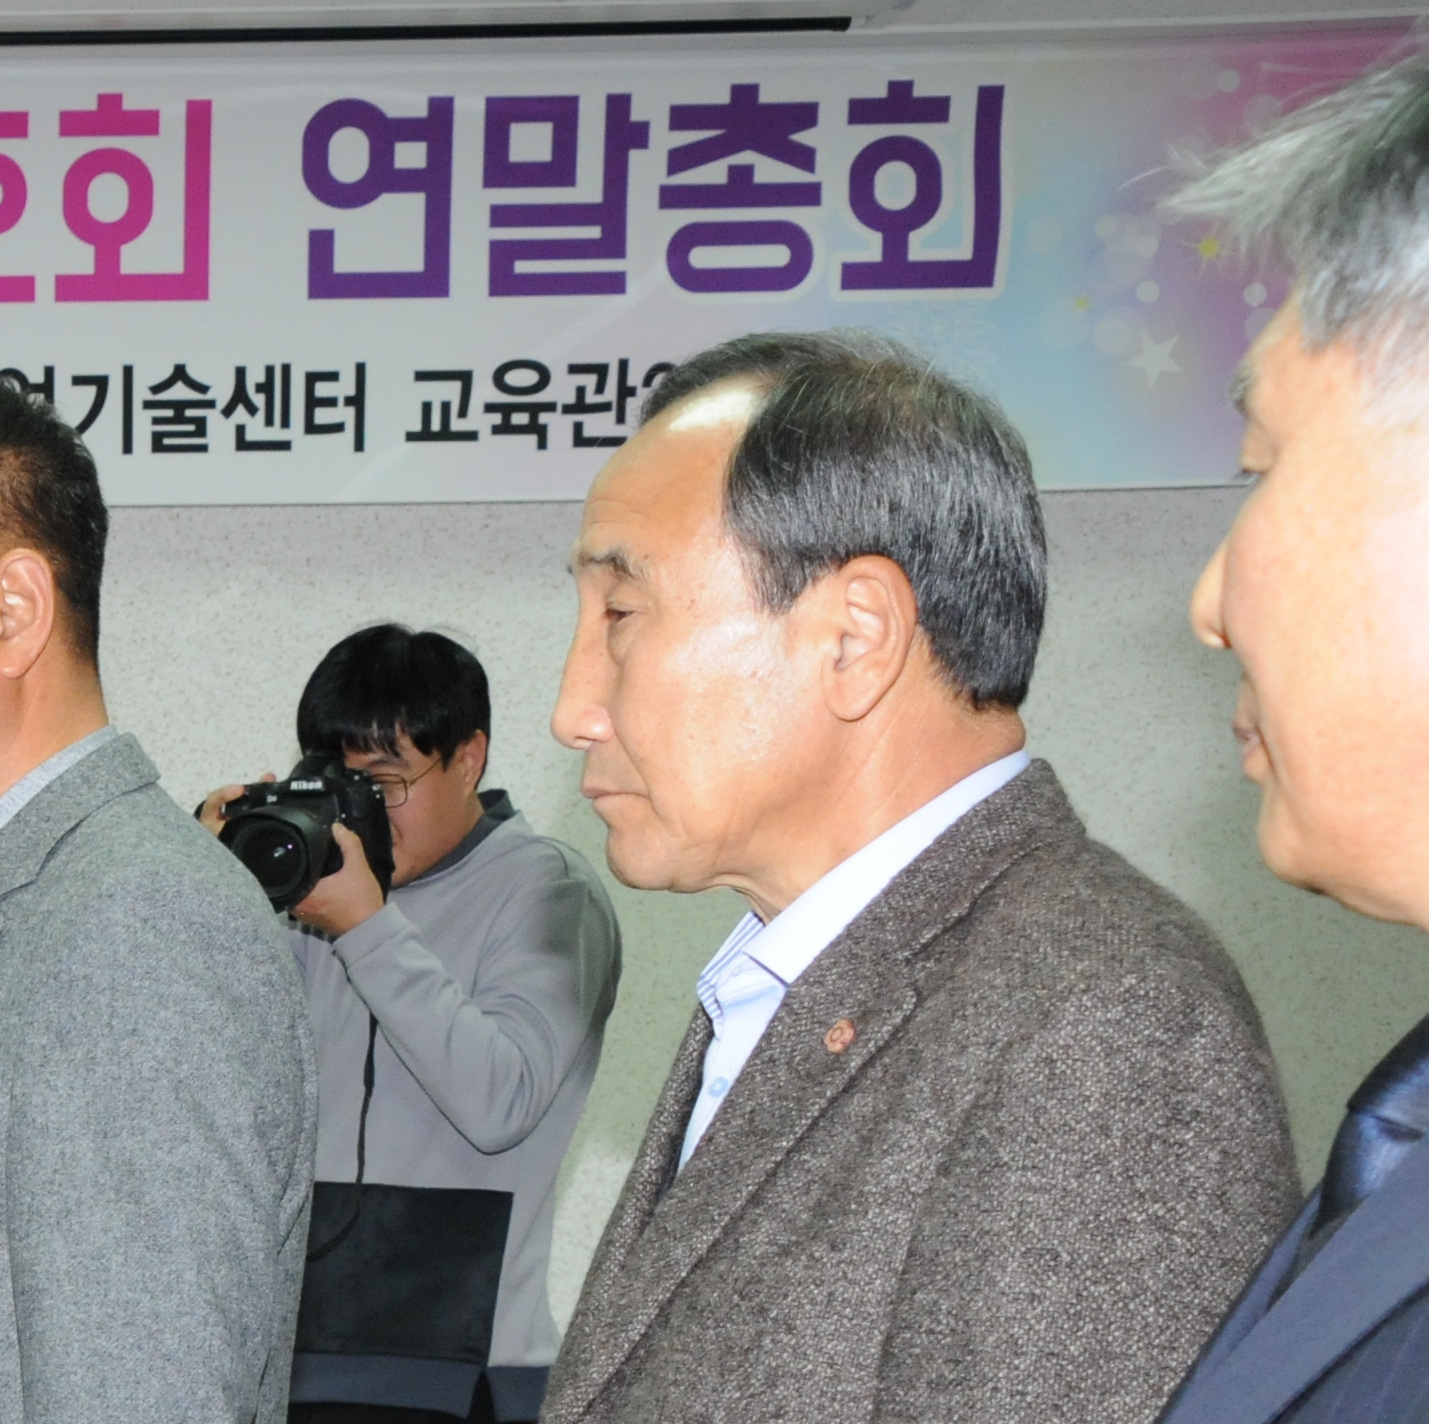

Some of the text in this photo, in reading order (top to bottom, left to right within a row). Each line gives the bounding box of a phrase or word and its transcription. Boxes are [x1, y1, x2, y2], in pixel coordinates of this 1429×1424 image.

[301, 80, 1003, 298] 연말총회
[405, 357, 678, 451] 교육관
[290, 780, 323, 791] Nikon
